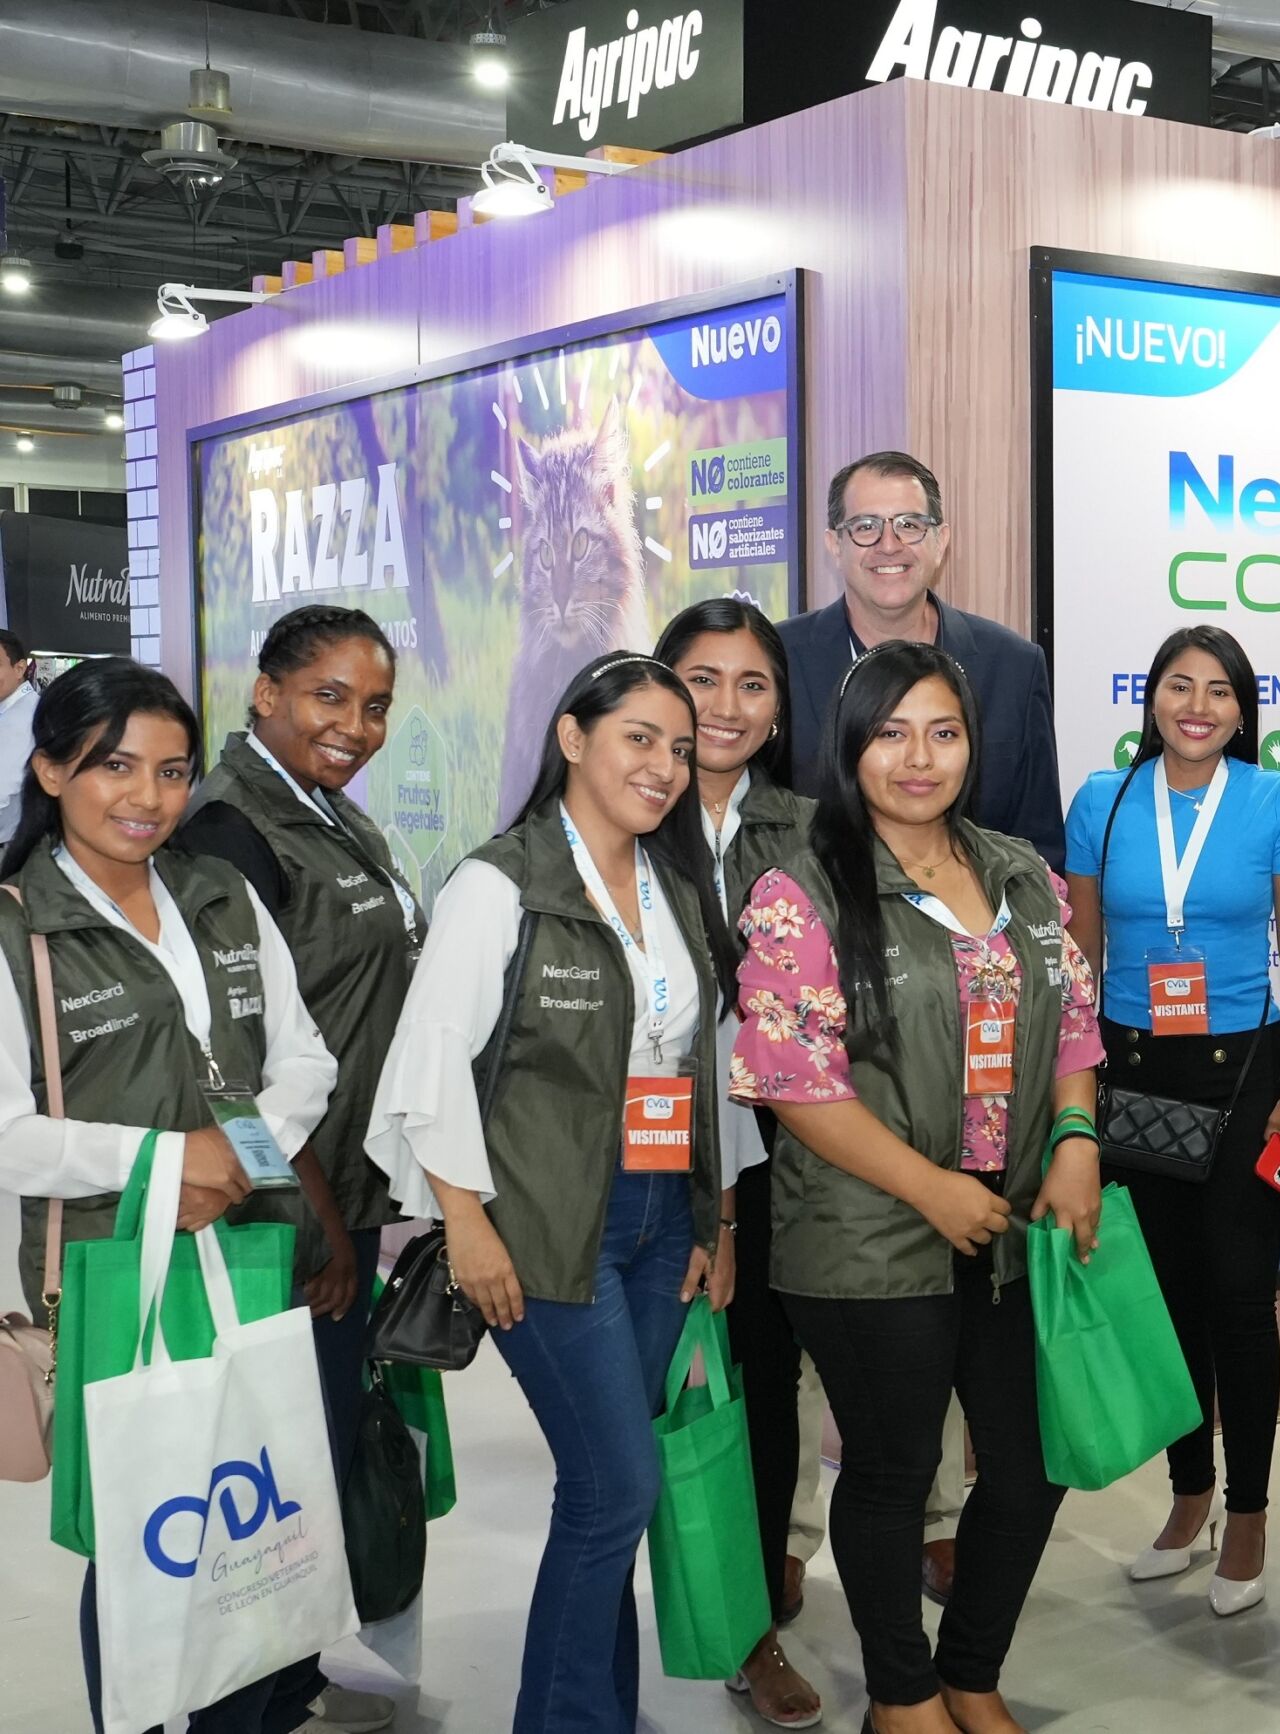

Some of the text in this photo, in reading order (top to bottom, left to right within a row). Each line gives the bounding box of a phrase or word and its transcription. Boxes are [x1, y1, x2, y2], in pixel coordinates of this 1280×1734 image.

[865, 0, 1153, 117] Agripac
[552, 9, 703, 142] Agripac
[691, 315, 781, 368] Nuevo
[1076, 315, 1226, 369] ¡NUEVO!
[727, 453, 771, 472] contiene
[727, 470, 785, 490] colorantes
[728, 514, 763, 529] contiene
[249, 462, 410, 602] RAZZA
[729, 527, 784, 544] saborizantes
[729, 543, 776, 559] artificiales
[80, 610, 111, 622] ALIMENTO
[433, 789, 440, 812] y
[395, 811, 445, 835] vegetales
[542, 964, 600, 981] NexGard
[1167, 979, 1188, 988] CVDL
[60, 982, 125, 1013] NexGard
[1154, 1003, 1206, 1017] VISITANTE
[970, 1053, 1012, 1070] VISITANTE
[628, 1130, 689, 1145] VISITANTE
[217, 1576, 269, 1605] CONGRESO
[219, 1604, 233, 1615] DE
[260, 1586, 273, 1599] EN
